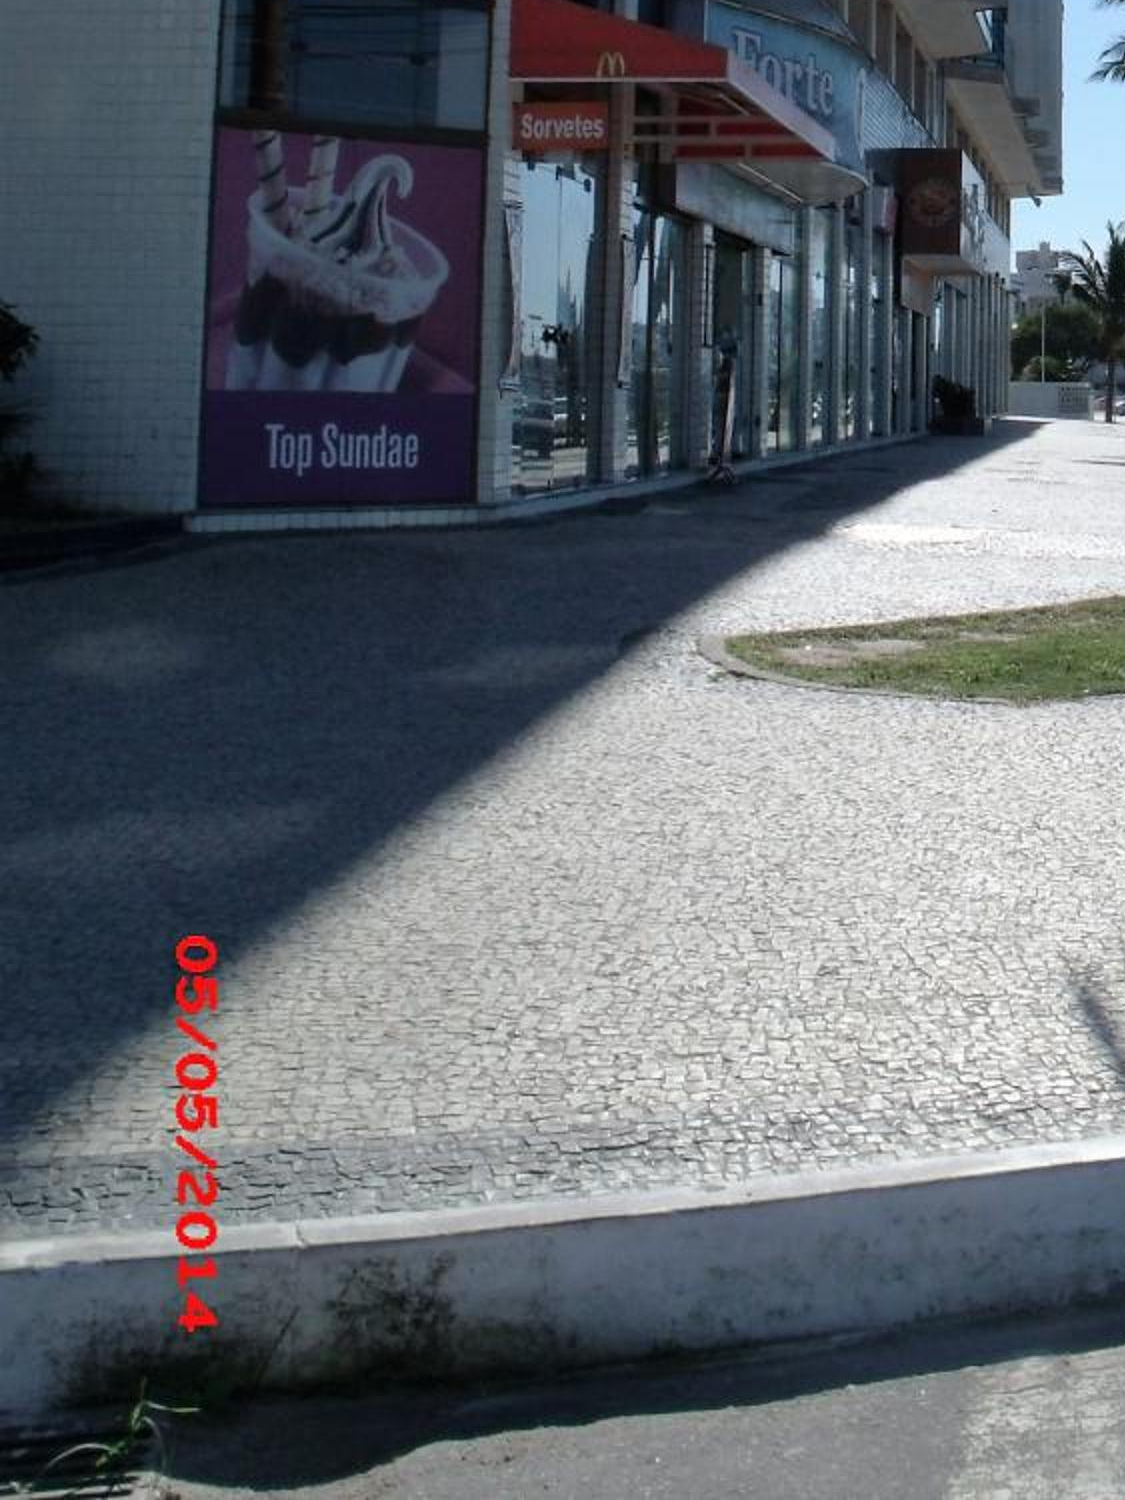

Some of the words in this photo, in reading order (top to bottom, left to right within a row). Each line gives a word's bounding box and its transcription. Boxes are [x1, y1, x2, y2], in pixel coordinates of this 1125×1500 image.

[520, 113, 605, 140] Sorvetes
[264, 423, 313, 477] Top
[321, 422, 419, 469] Sundae
